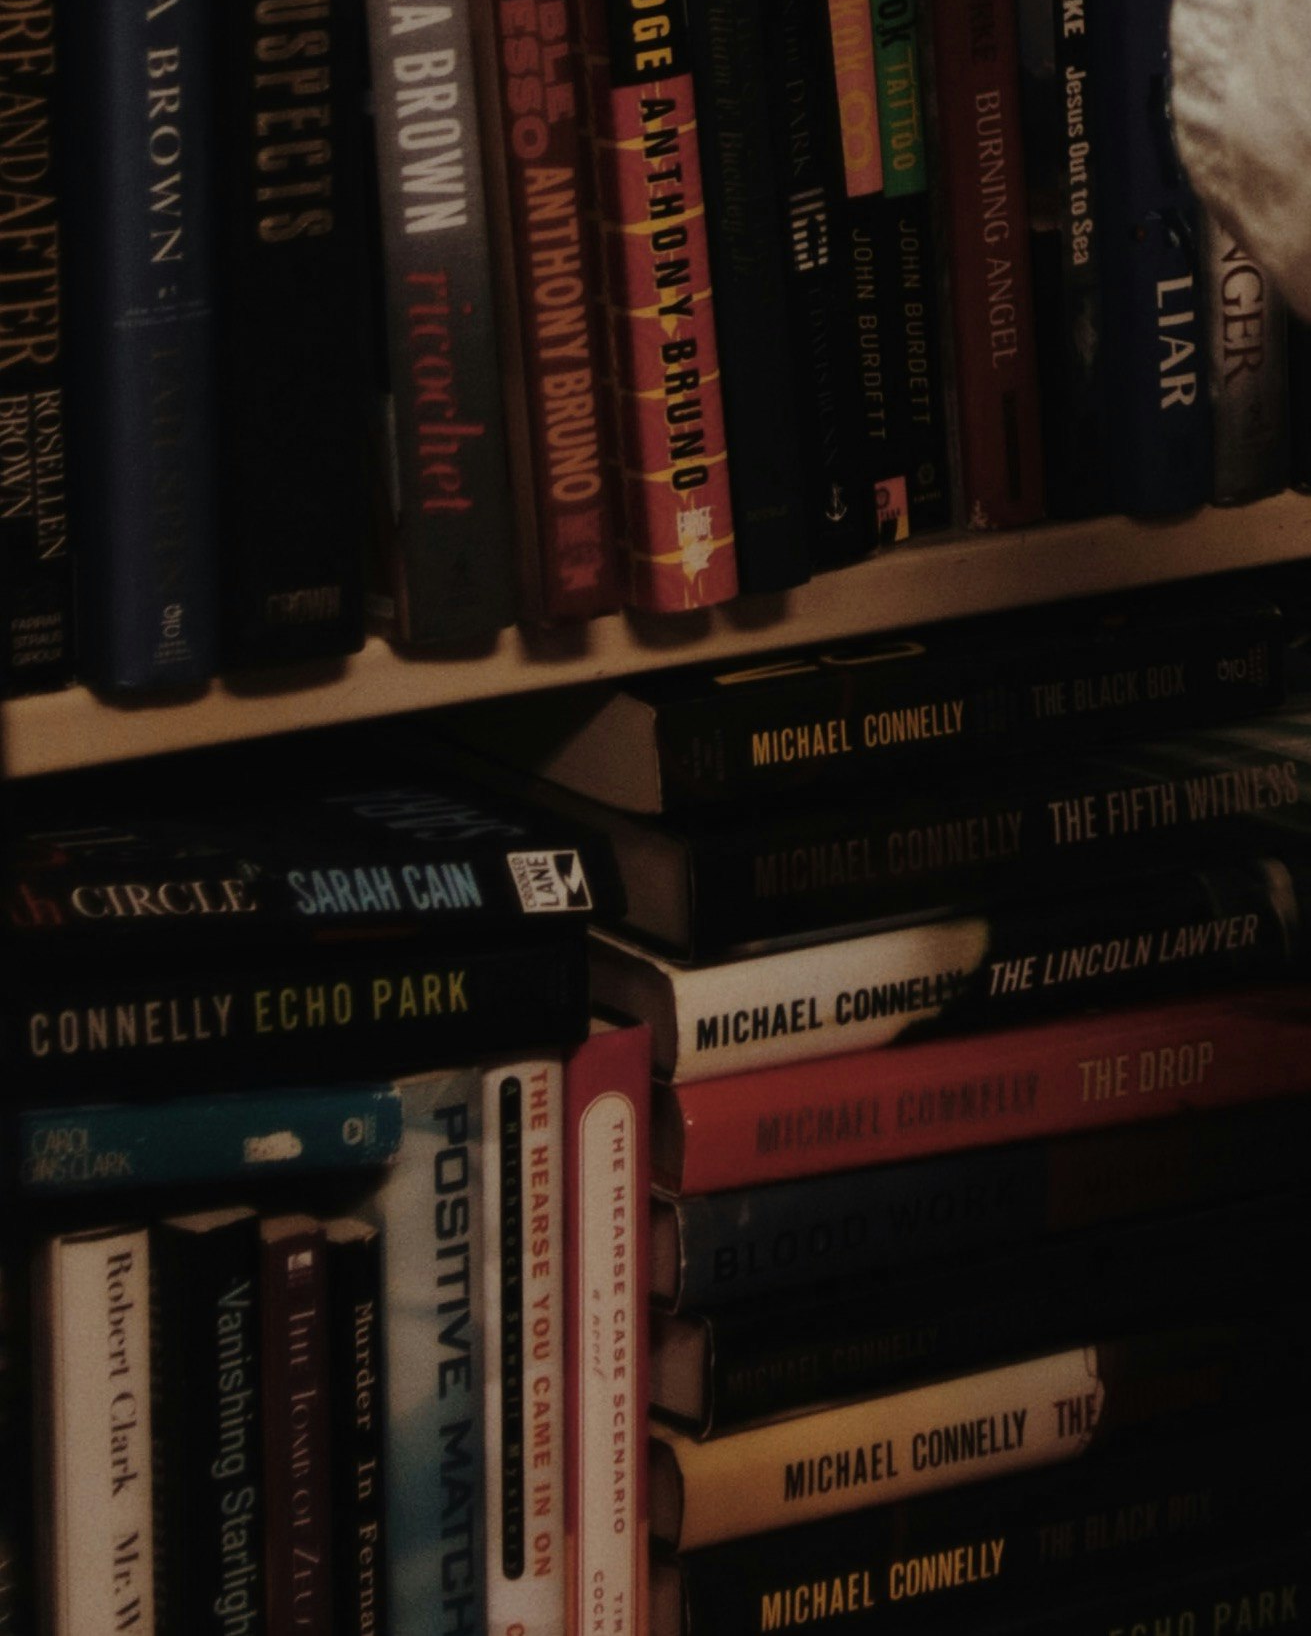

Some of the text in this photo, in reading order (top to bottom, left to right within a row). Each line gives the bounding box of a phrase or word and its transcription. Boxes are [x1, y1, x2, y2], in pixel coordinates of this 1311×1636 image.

[390, 47, 471, 234] BROWN
[885, 46, 923, 173] TATTOO
[1063, 65, 1089, 139] Jesus
[1067, 141, 1090, 190] Out
[1070, 193, 1089, 216] to
[1070, 217, 1092, 267] Sea
[639, 98, 709, 492] ANTHONY BRUNO
[1154, 270, 1199, 411] LIAR
[403, 269, 486, 513] ricochet
[69, 860, 483, 919] CIRCLE SARAH CAIN
[27, 969, 471, 1060] CONNELLY ECHO PARK
[696, 912, 1261, 1051] MICHAEL CONNELLY THE LINCOLN LAWYER
[105, 1250, 138, 1497] Robert Clark
[433, 1105, 477, 1636] POSITIVE MATCH
[611, 1118, 627, 1536] THE HEARSE CASE SCENARIO
